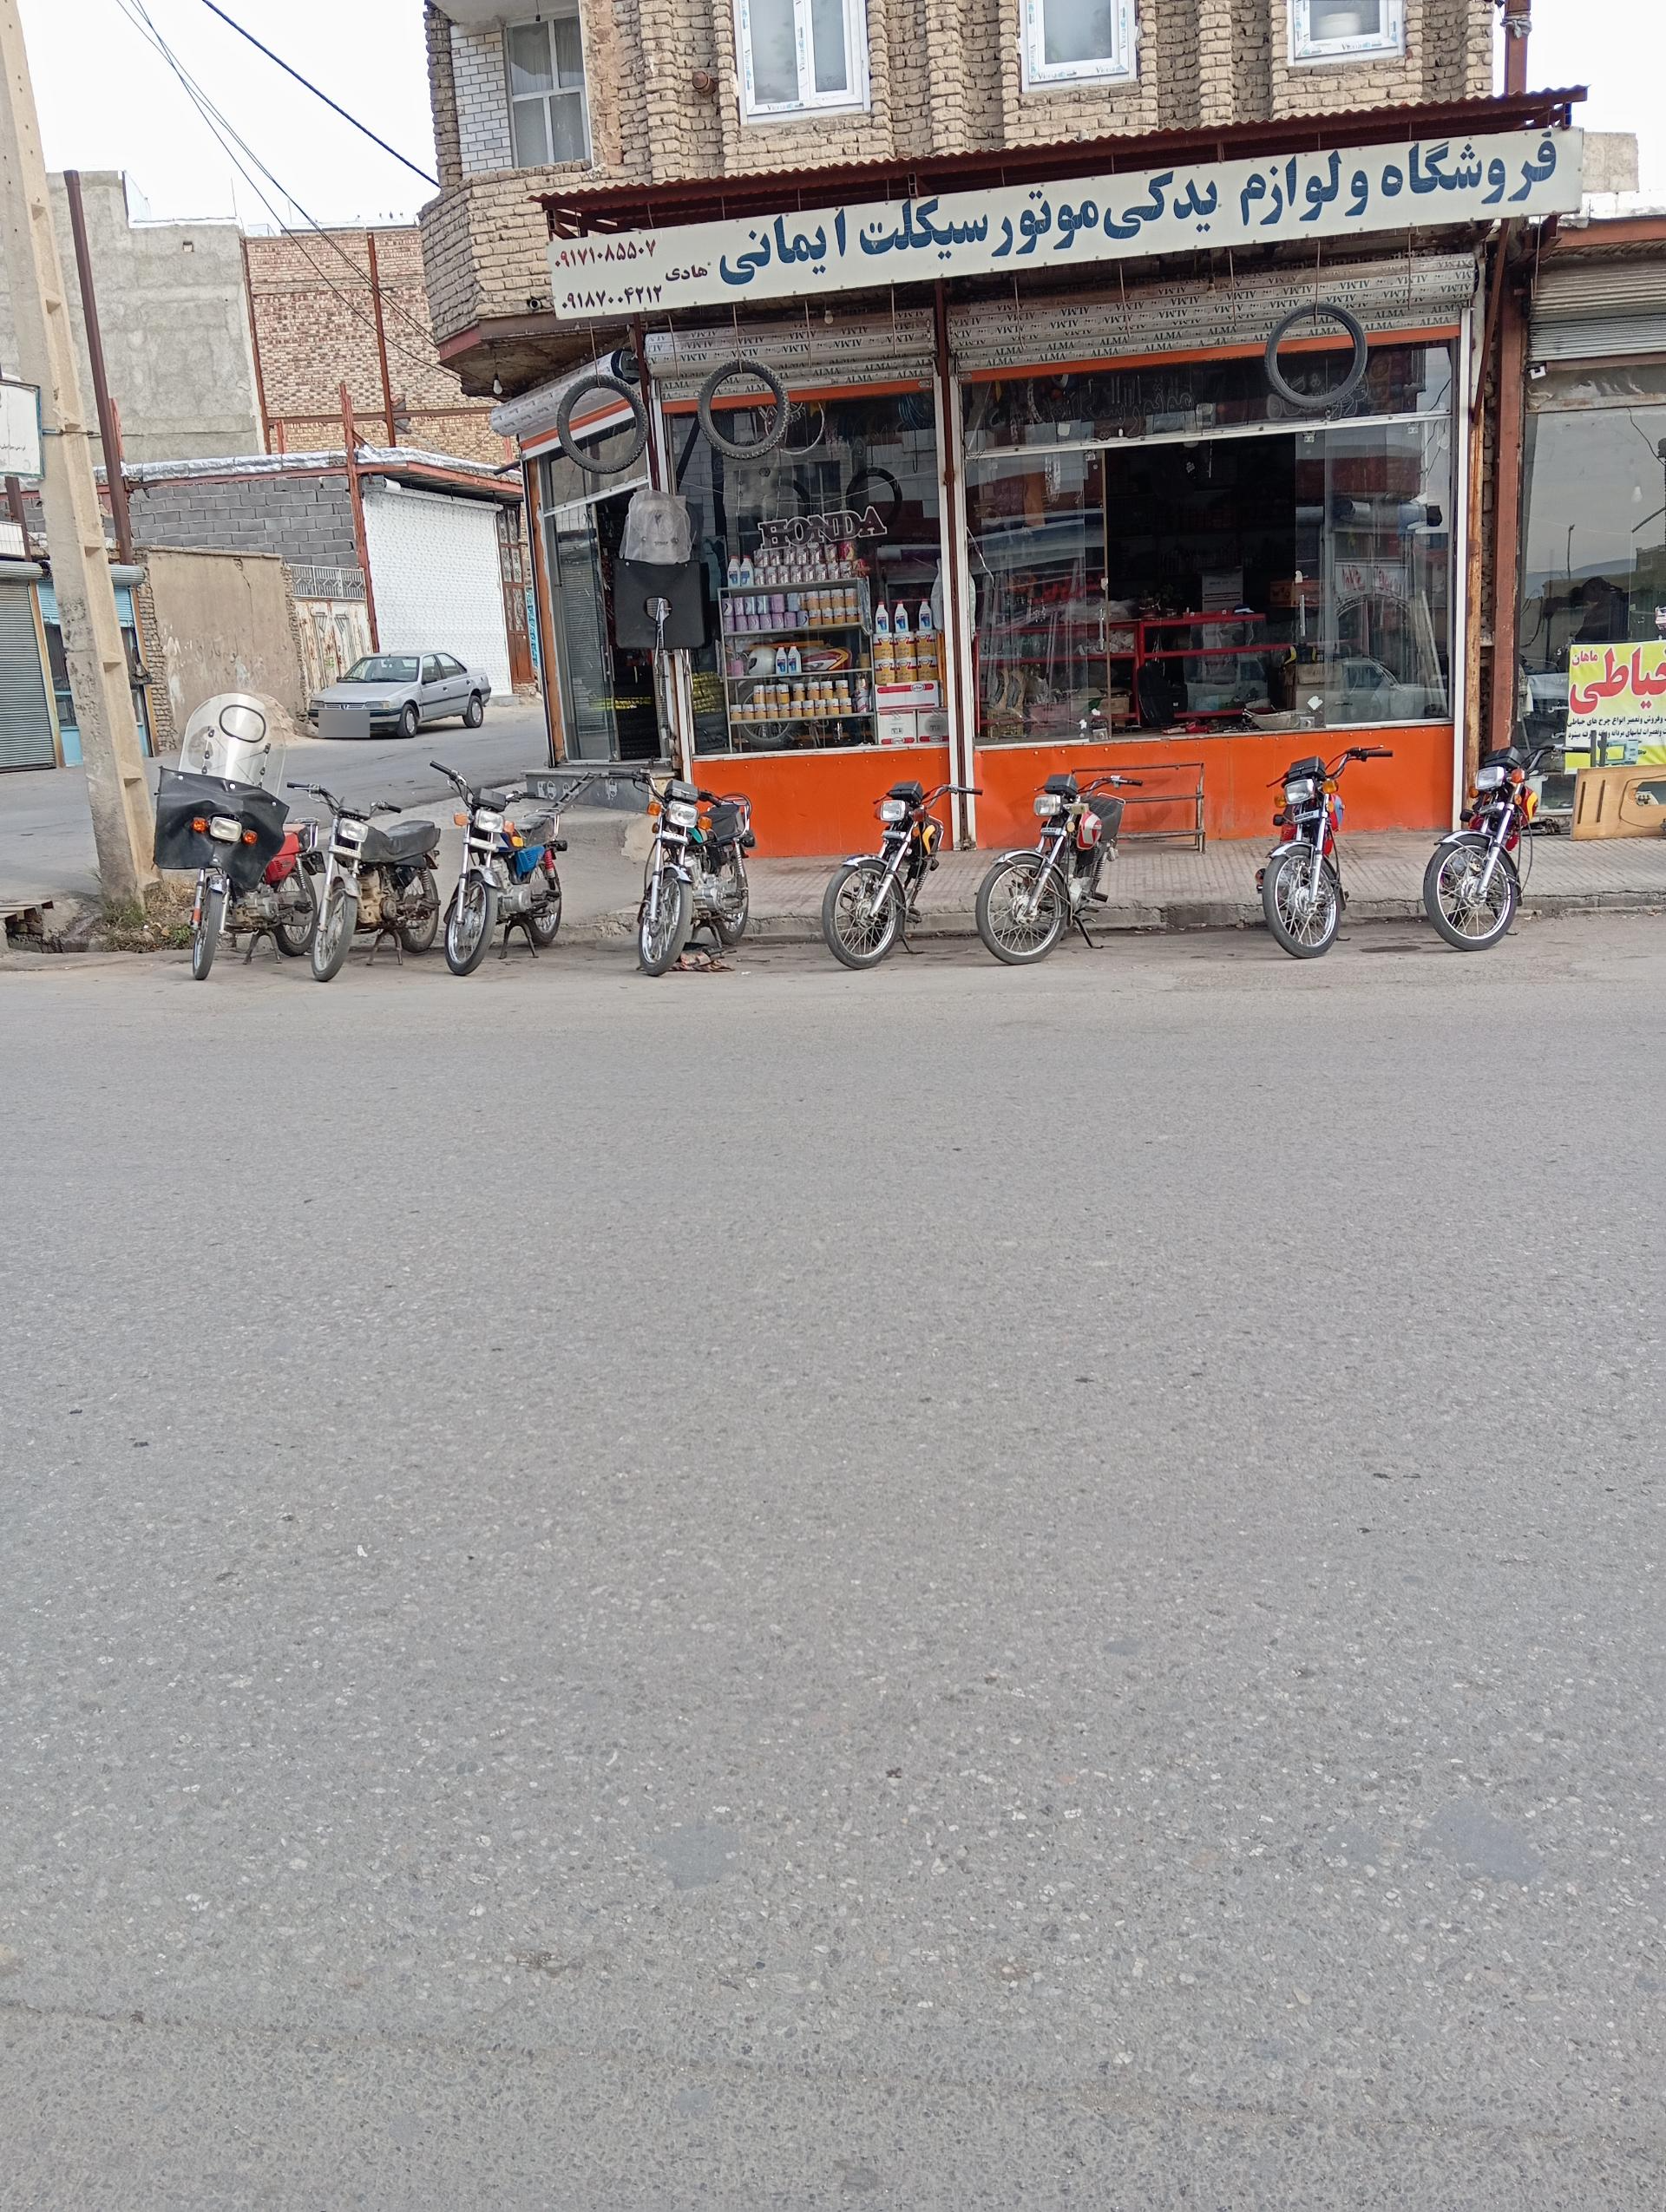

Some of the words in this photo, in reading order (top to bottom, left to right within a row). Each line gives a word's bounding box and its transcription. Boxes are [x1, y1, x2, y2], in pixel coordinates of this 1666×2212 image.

[1381, 130, 1558, 205] فروشگاه
[859, 198, 988, 260] سیکلت
[991, 189, 1099, 259] موتور
[1104, 170, 1217, 239] یدکی
[666, 264, 708, 282] هادی
[719, 208, 846, 285] ایمانی
[758, 506, 887, 551] HONDA
[1571, 650, 1598, 666] ماهان
